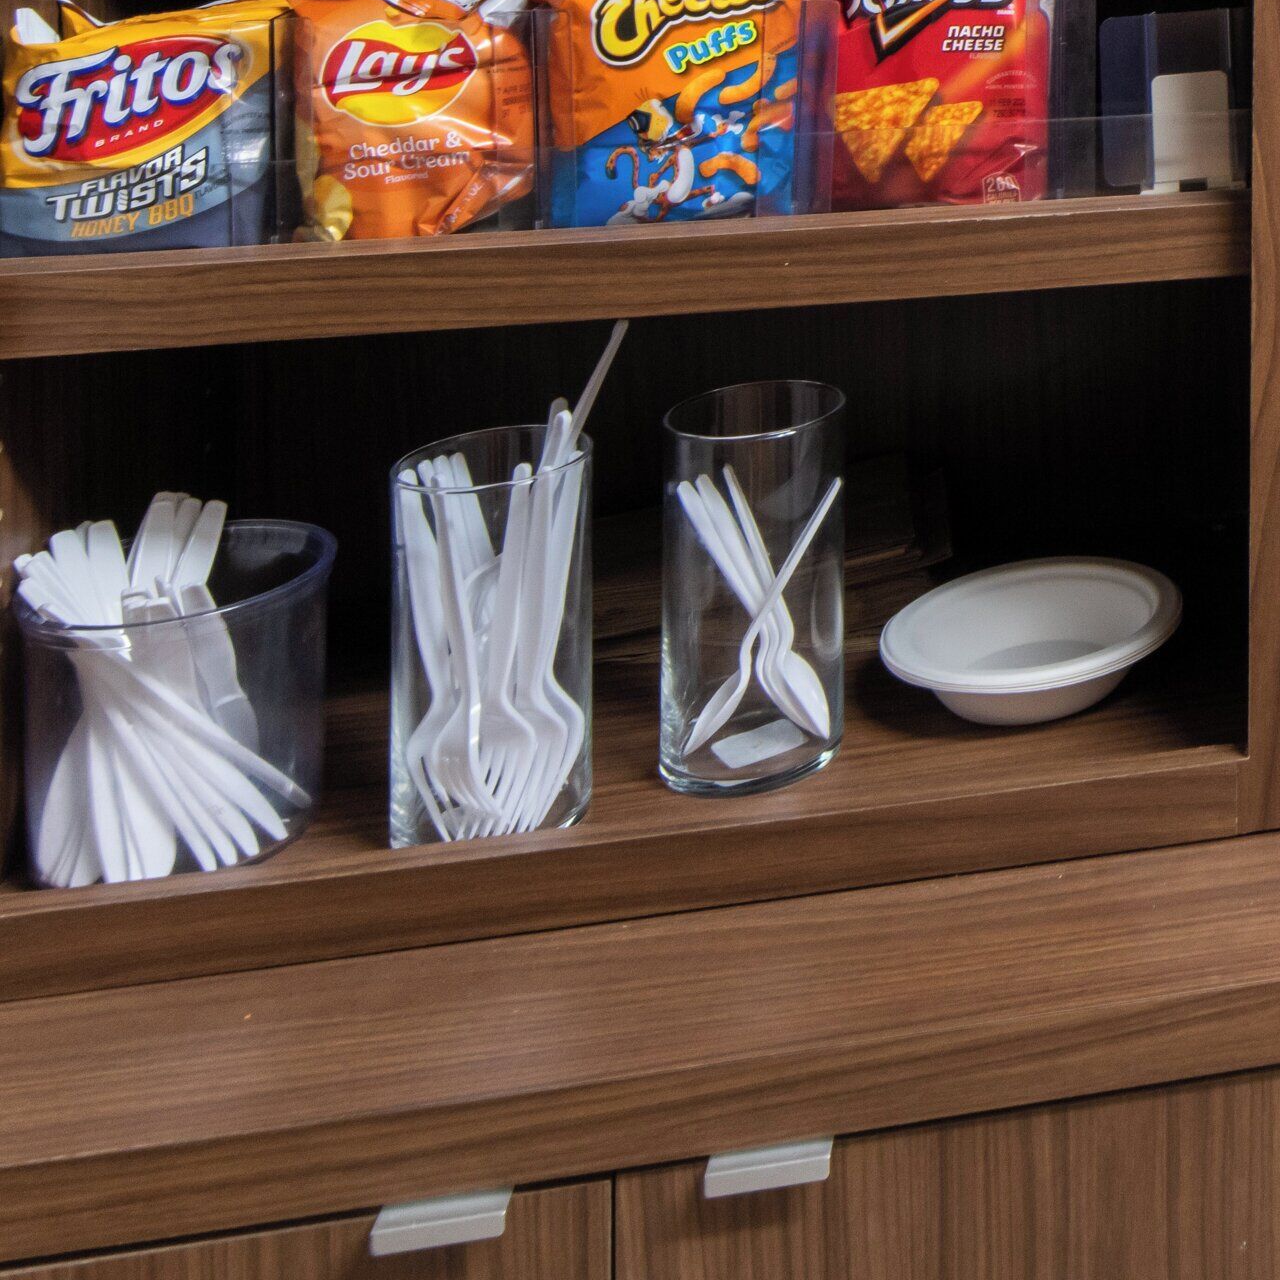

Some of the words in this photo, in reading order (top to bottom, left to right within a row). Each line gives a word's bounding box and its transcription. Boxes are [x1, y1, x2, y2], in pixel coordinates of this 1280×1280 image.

[668, 21, 755, 73] Puffs
[941, 38, 1005, 52] CHEESE
[948, 25, 1006, 38] NACHO
[332, 41, 465, 96] Lay's
[16, 43, 244, 156] Fritos
[94, 119, 165, 148] BRAND
[350, 136, 440, 160] Cheddar
[446, 131, 462, 147] &
[79, 145, 183, 197] FLAVOR
[343, 158, 394, 180] Sour
[401, 150, 471, 171] Cream
[385, 170, 429, 184] Flavored
[48, 149, 208, 220] TWISTS
[71, 212, 142, 239] HONEY
[149, 194, 195, 225] BBQ
